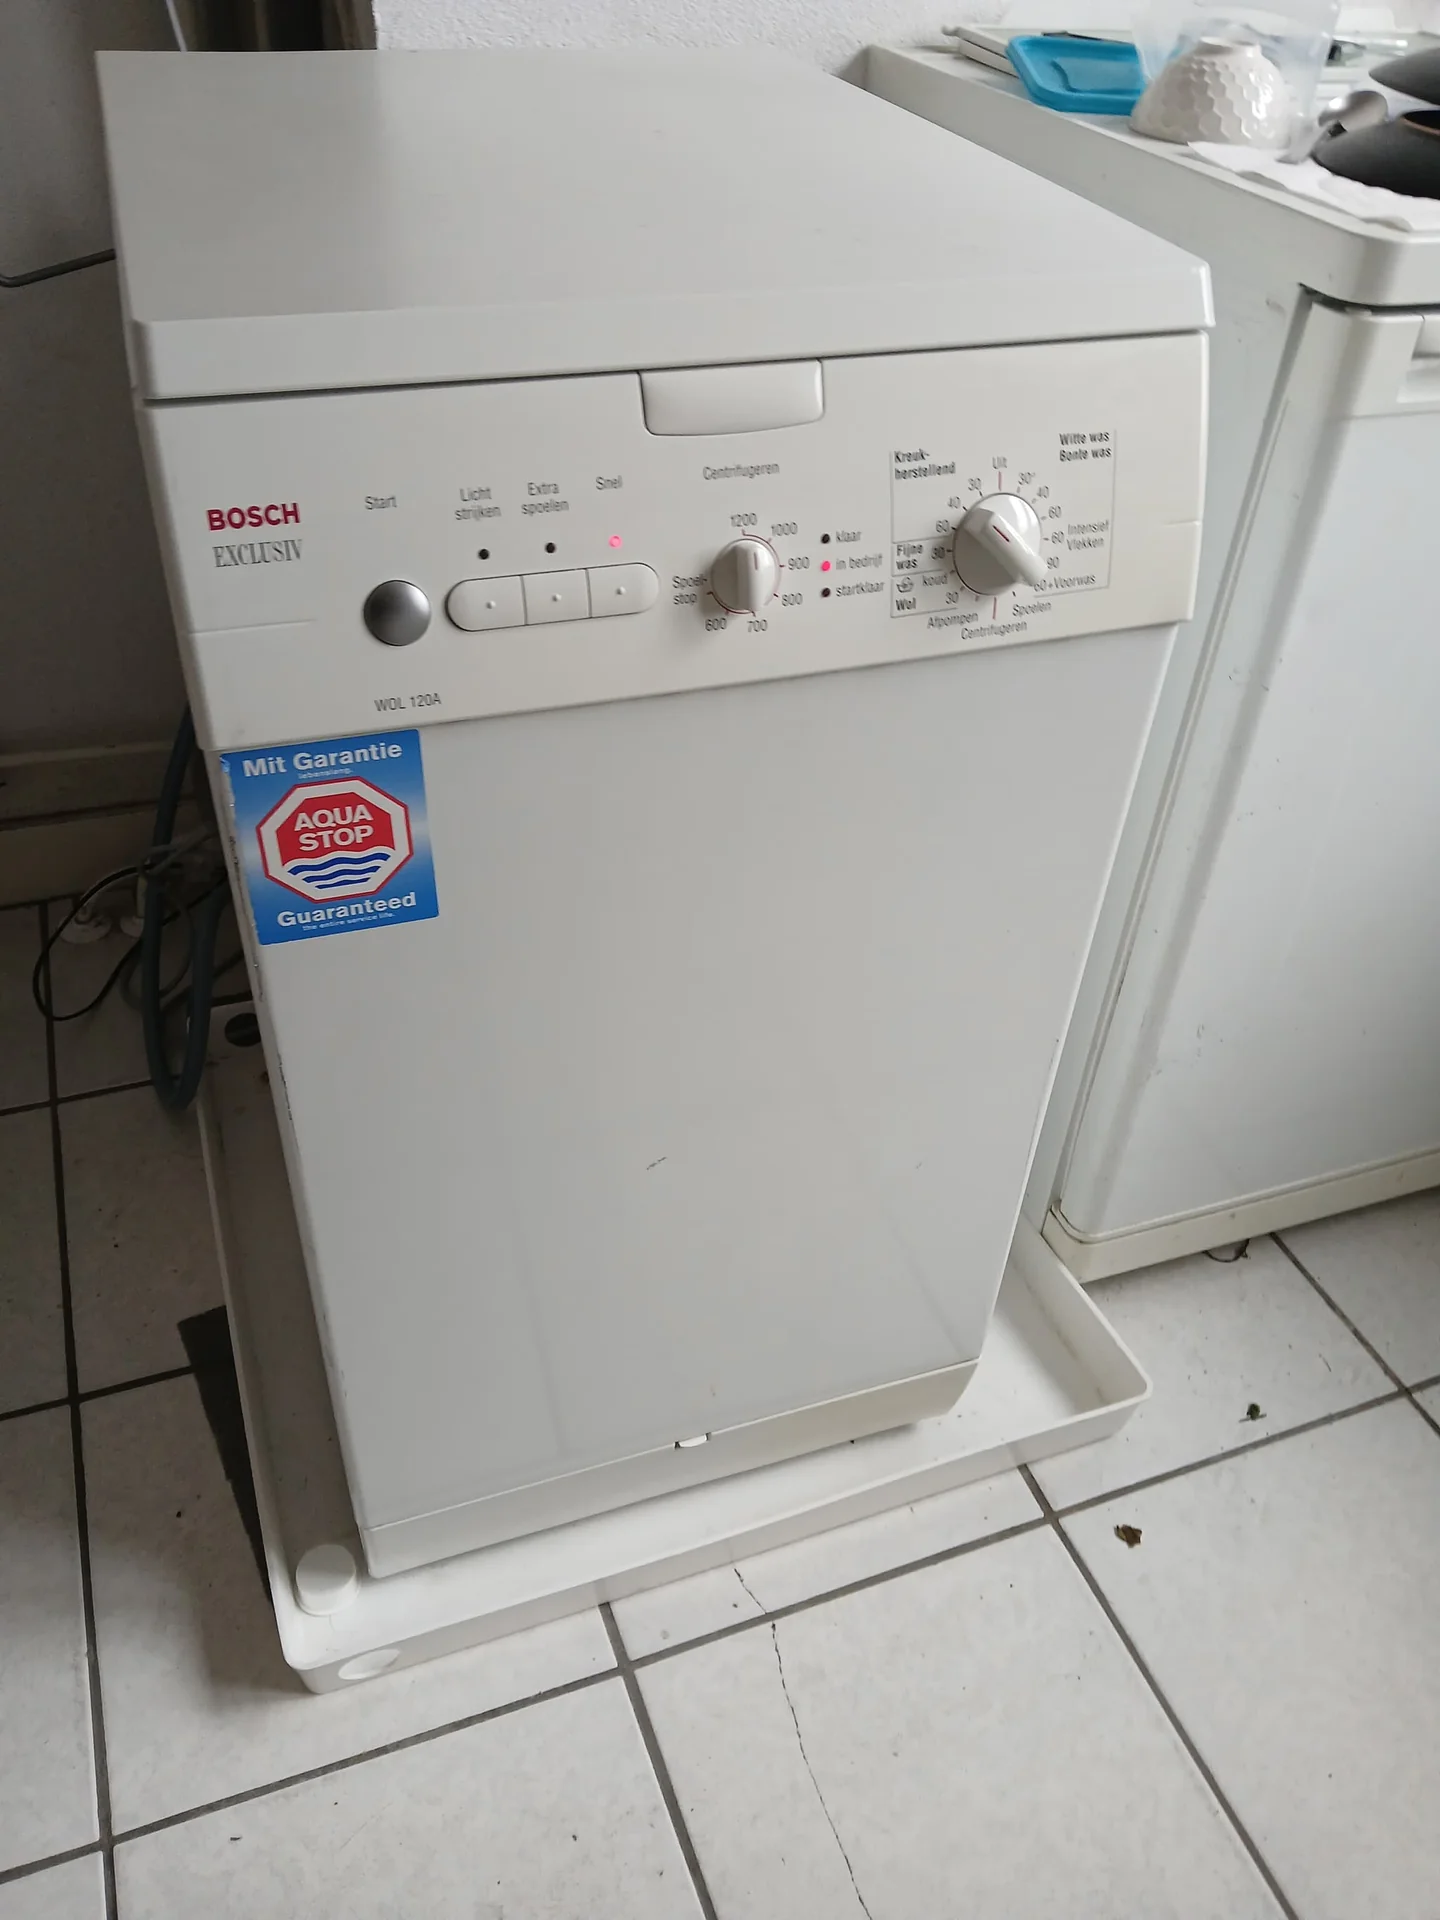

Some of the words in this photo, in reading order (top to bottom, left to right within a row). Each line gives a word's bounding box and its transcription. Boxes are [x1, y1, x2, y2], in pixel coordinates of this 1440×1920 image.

[1059, 432, 1087, 446] Witte
[1089, 431, 1110, 442] was
[1059, 448, 1088, 462] Bonte
[1091, 447, 1112, 458] was
[894, 461, 957, 480] herstellend
[992, 456, 1008, 470] Uit
[703, 462, 781, 481] Centrifugeren
[527, 480, 560, 497] Extra
[595, 475, 623, 491] Snel
[967, 477, 982, 492] 30
[459, 485, 493, 502] Licht
[1036, 485, 1050, 499] 40
[364, 495, 398, 511] Start
[521, 498, 570, 517] spoelen
[947, 495, 962, 509] 40
[206, 501, 301, 532] BOSCH
[454, 503, 502, 521] strijken
[730, 512, 758, 528] 1200
[1048, 505, 1062, 519] 60
[771, 521, 799, 537] 1000
[936, 519, 950, 533] 60
[1067, 519, 1109, 535] Intensief
[835, 529, 862, 543] klaar
[1051, 530, 1065, 544] 60
[1066, 537, 1105, 551] Vlekken
[212, 538, 303, 568] EXCLUSIV
[896, 543, 924, 558] Fijne
[787, 556, 811, 571] 900
[836, 558, 847, 571] in
[848, 552, 884, 569] bedrijf
[896, 558, 919, 570] was
[1046, 556, 1060, 570] 90
[922, 572, 949, 587] koud
[835, 580, 885, 598] startklaar
[673, 592, 698, 606] stop
[781, 592, 804, 607] 800
[895, 597, 917, 611] Wol
[945, 591, 960, 605] 30
[1012, 600, 1052, 617] Spoelen
[705, 617, 728, 632] 600
[747, 619, 768, 633] 700
[926, 612, 979, 629] Afpompen
[961, 621, 1028, 641] Centrifugeren
[374, 696, 406, 712] WOL
[410, 692, 442, 709] 120A
[242, 757, 288, 777] Mit
[292, 742, 404, 771] Garantie
[293, 804, 374, 832] AQUA
[298, 825, 375, 852] STOP
[276, 891, 418, 928] Guaranteed
